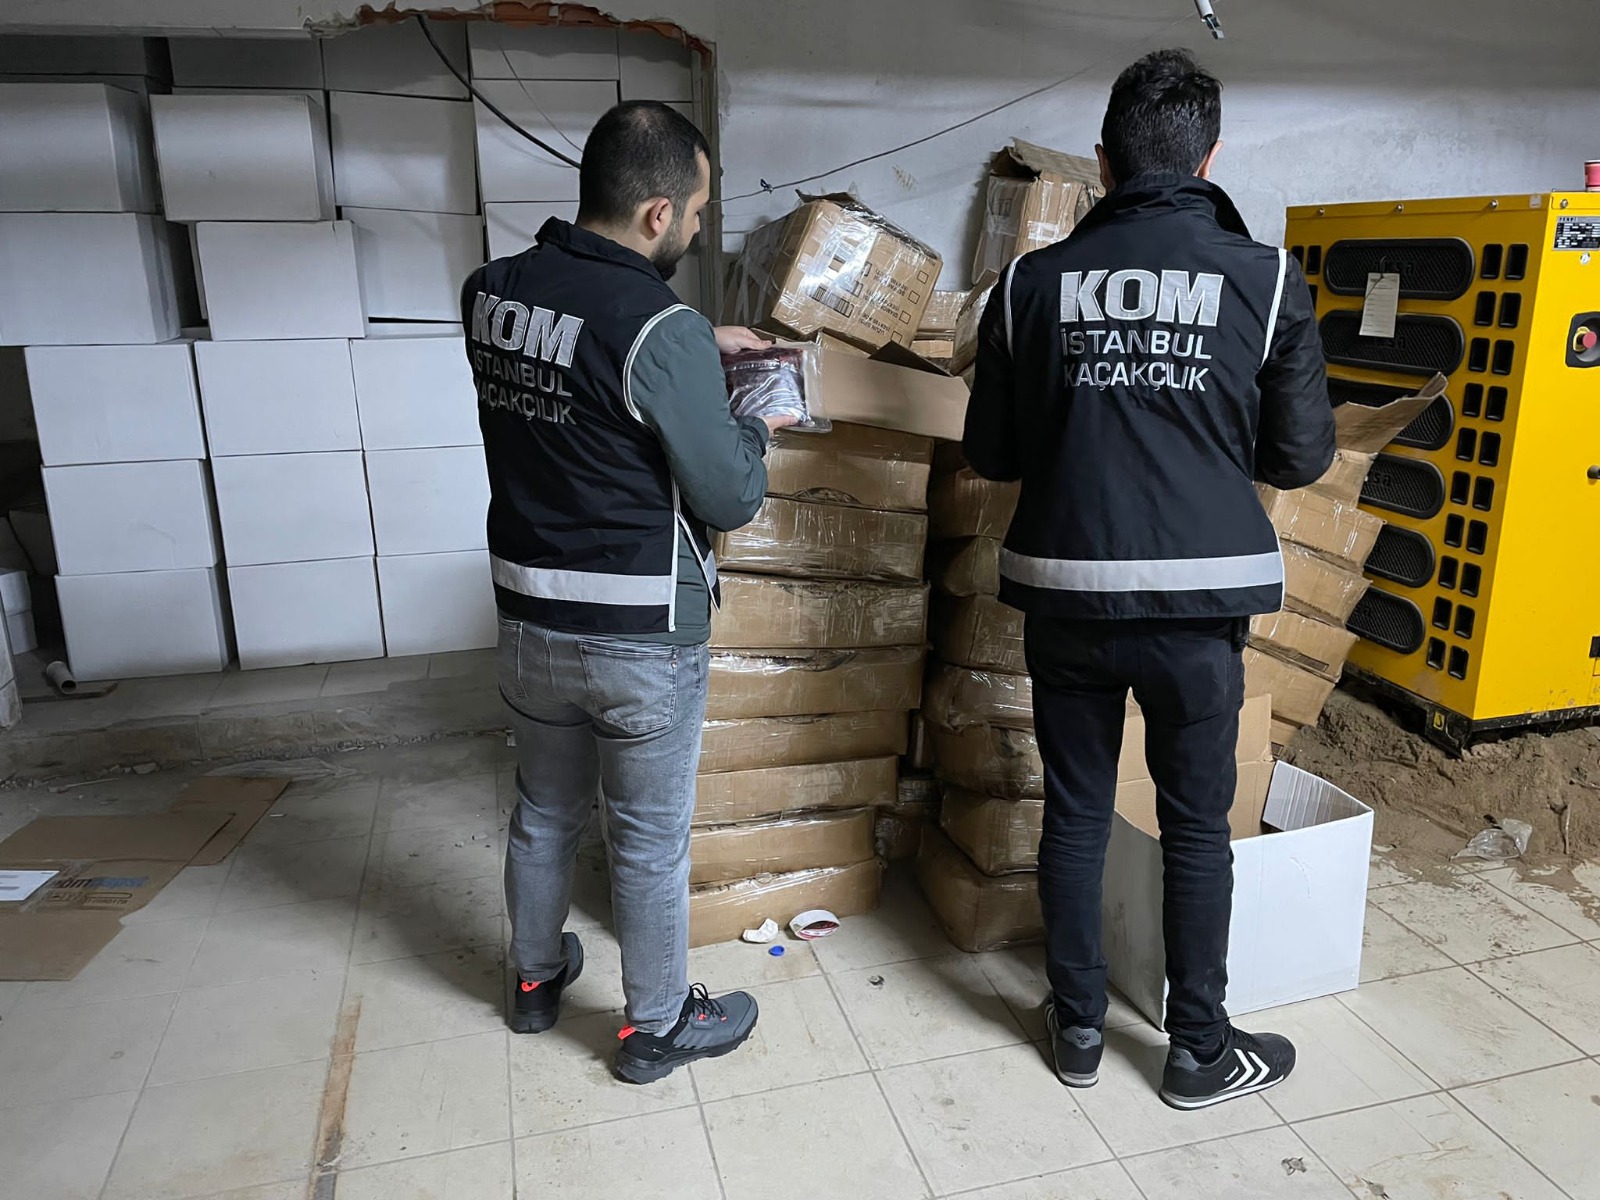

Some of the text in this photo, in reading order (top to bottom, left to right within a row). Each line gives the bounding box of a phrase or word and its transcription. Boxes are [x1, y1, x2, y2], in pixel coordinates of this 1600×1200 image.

[1060, 269, 1224, 327] KOM
[472, 291, 584, 368] KOM
[1061, 328, 1212, 360] İSTANBUL
[1064, 361, 1210, 392] KAÇAKÇILIK
